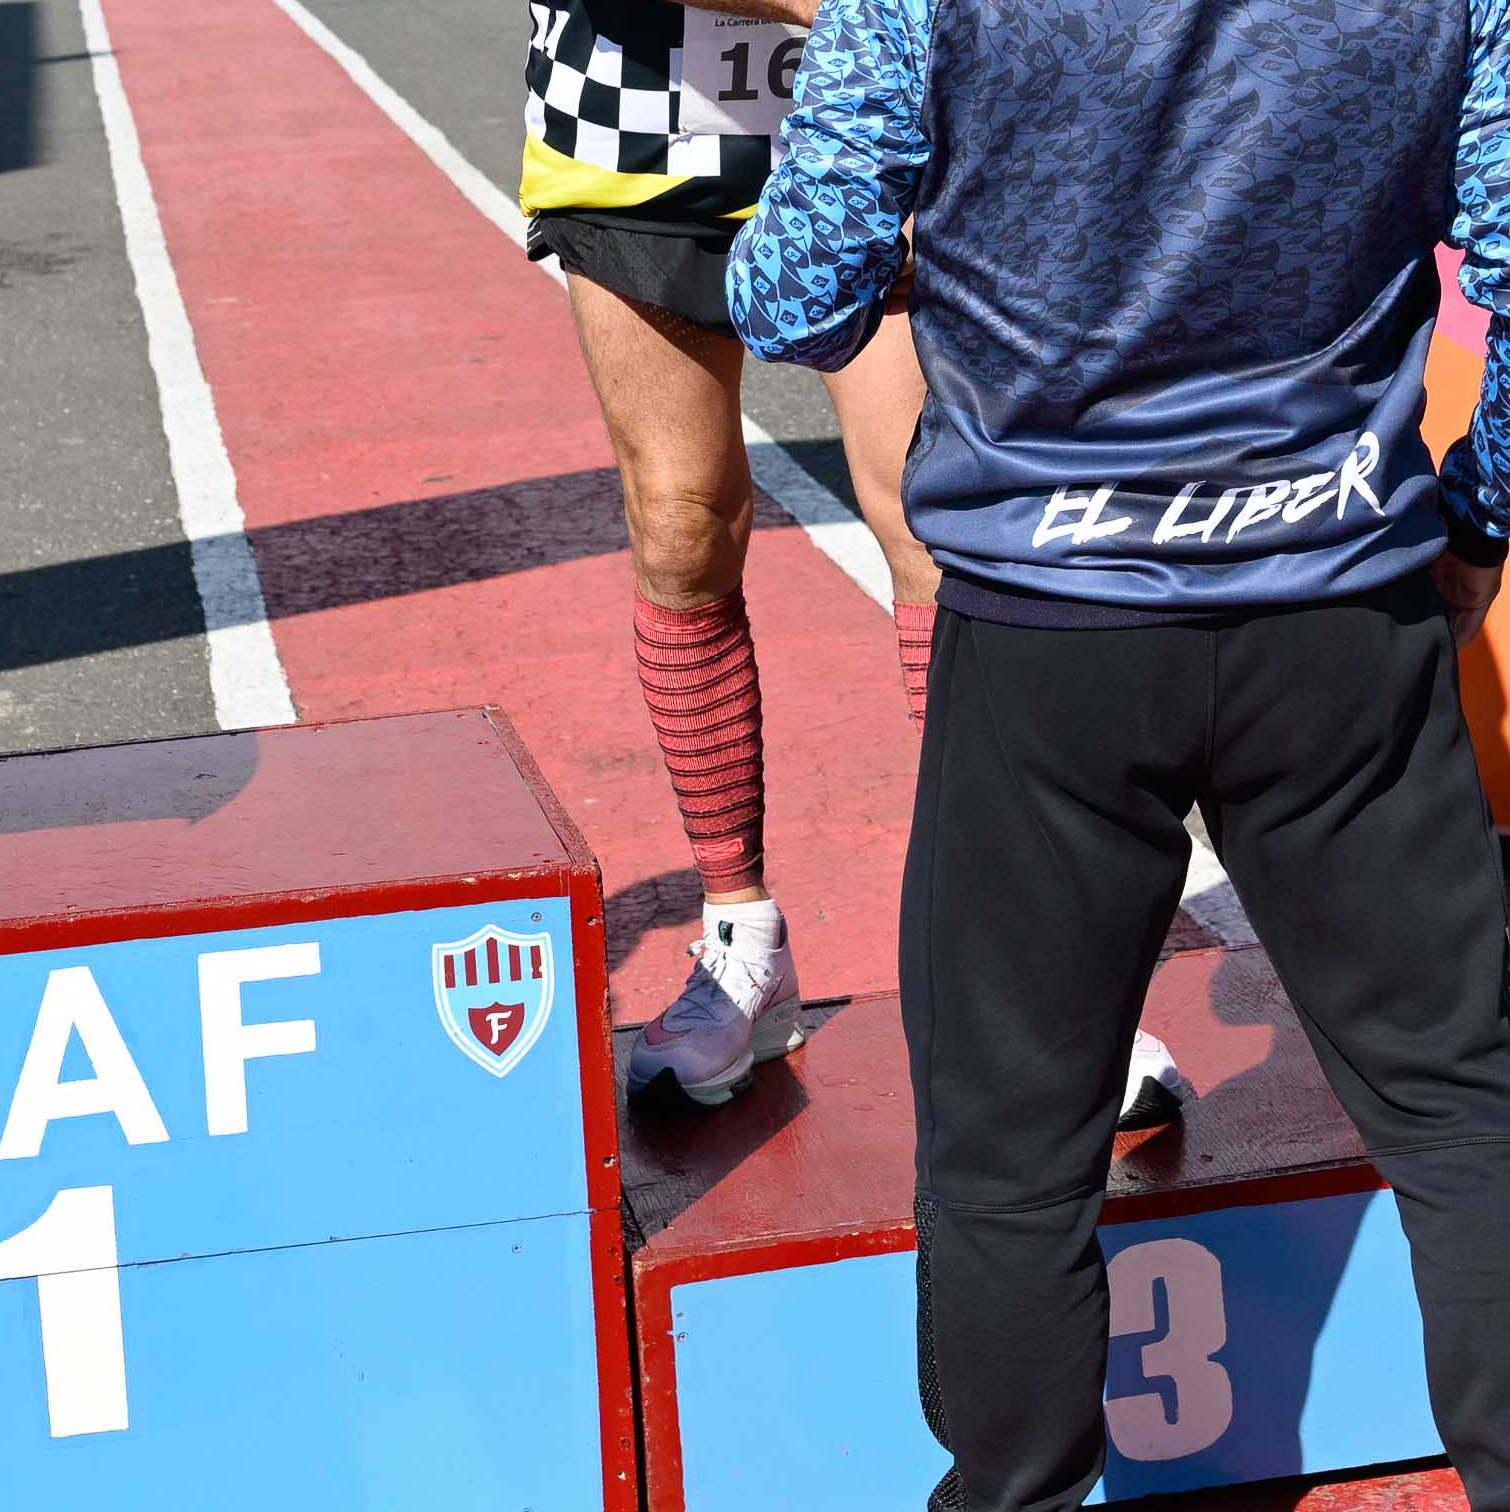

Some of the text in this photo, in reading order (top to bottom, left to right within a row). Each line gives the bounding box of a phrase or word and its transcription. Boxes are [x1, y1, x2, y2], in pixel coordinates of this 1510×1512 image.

[1031, 431, 1387, 549] EL LIBER
[1104, 1236, 1233, 1461] 3
